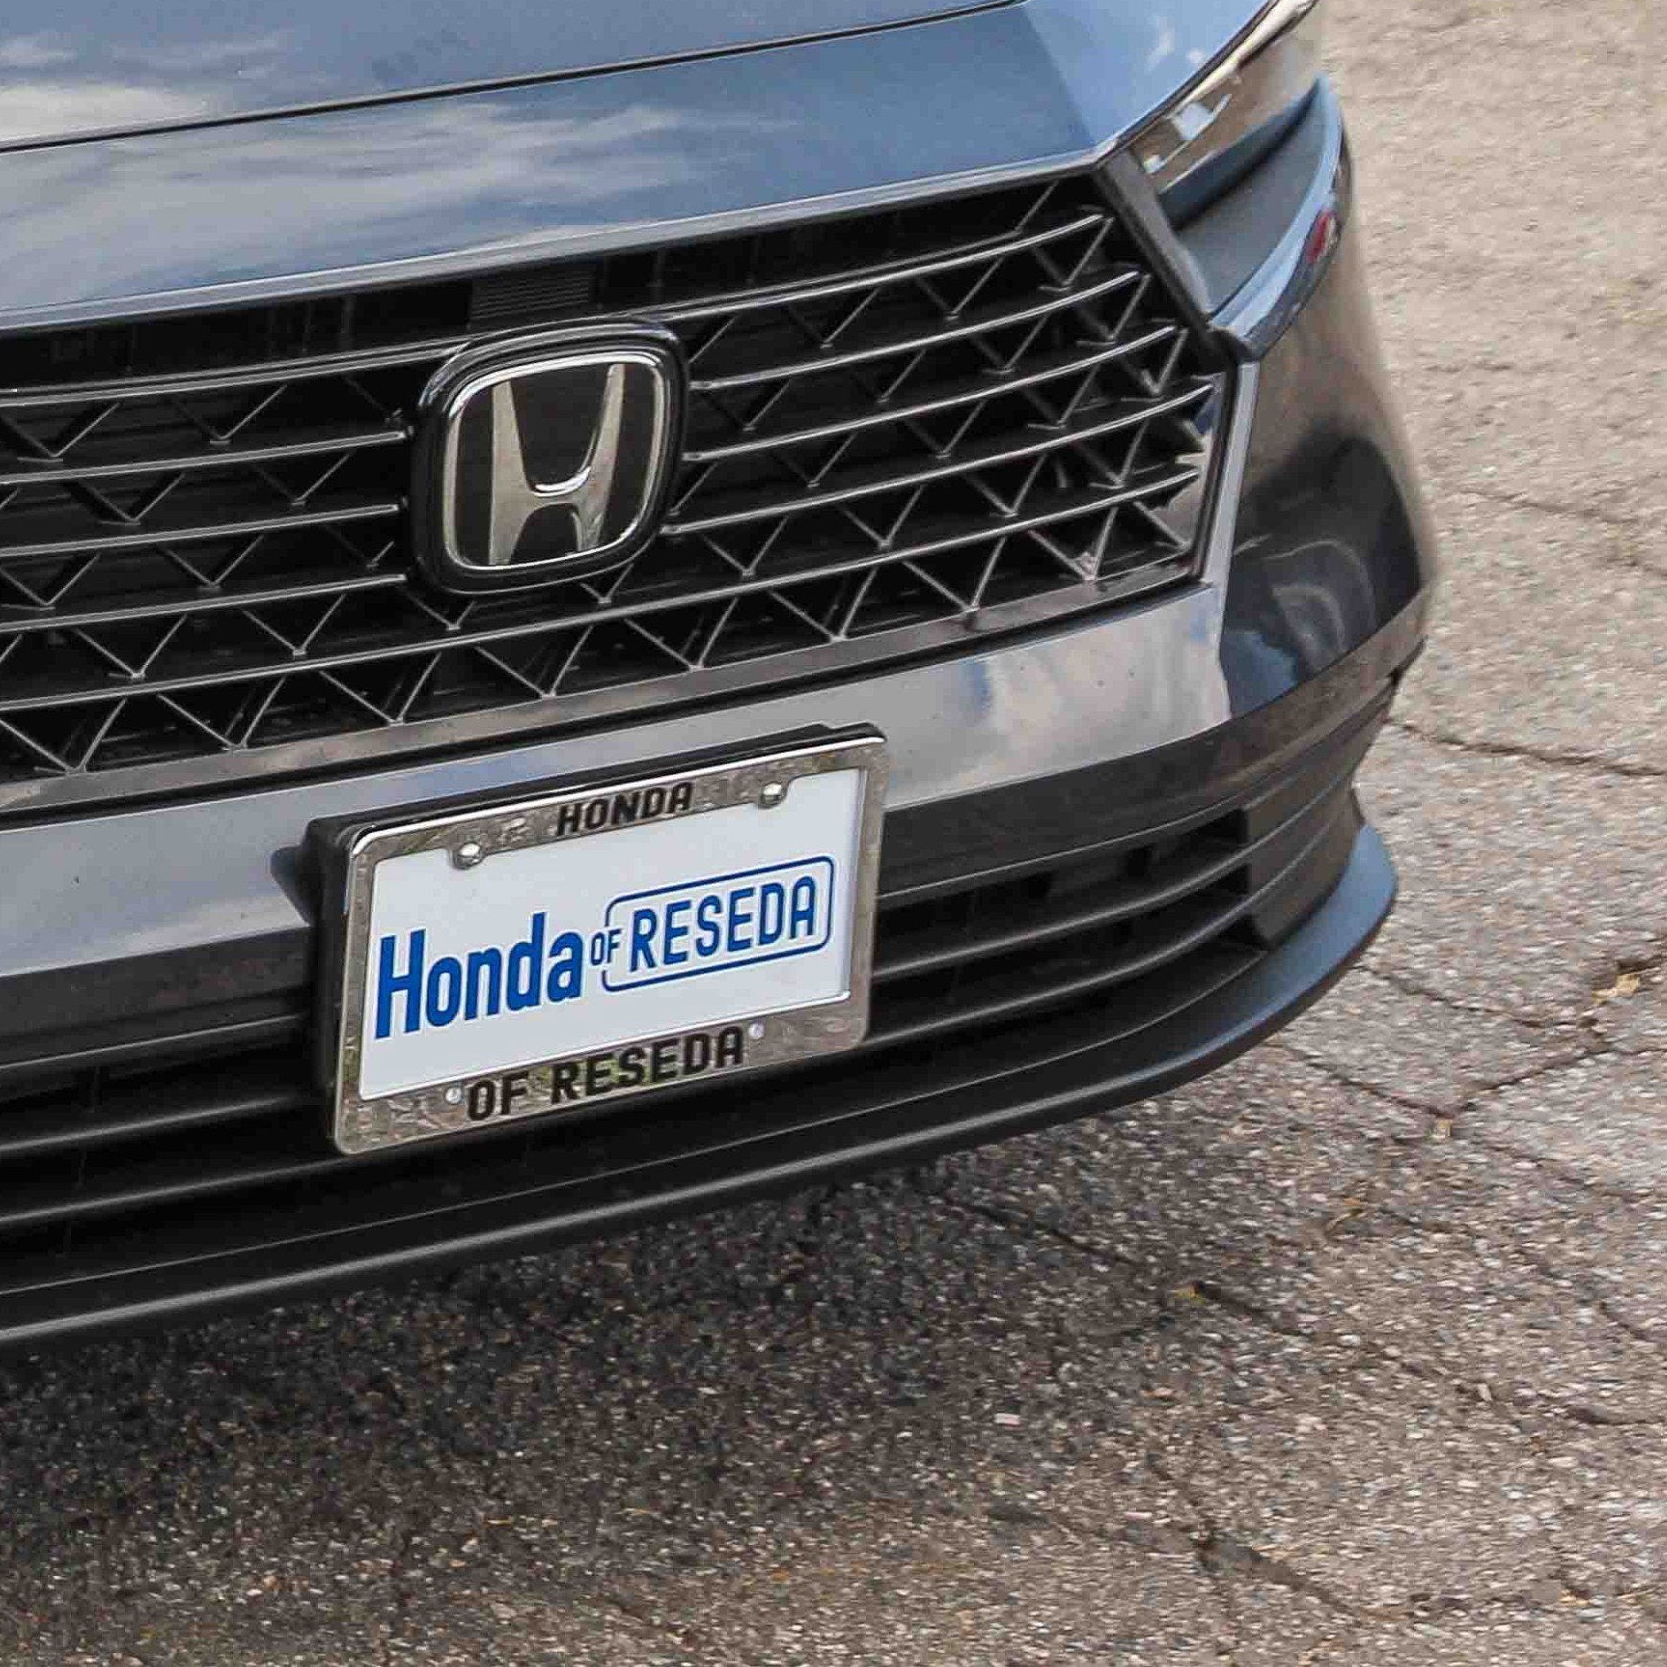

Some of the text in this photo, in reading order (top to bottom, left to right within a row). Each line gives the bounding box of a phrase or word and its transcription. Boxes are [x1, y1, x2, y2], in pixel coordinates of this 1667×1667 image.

[556, 781, 693, 836] HONDA
[374, 875, 816, 1039] Honda OF RESEDA
[467, 1025, 745, 1122] OF RESEDA
